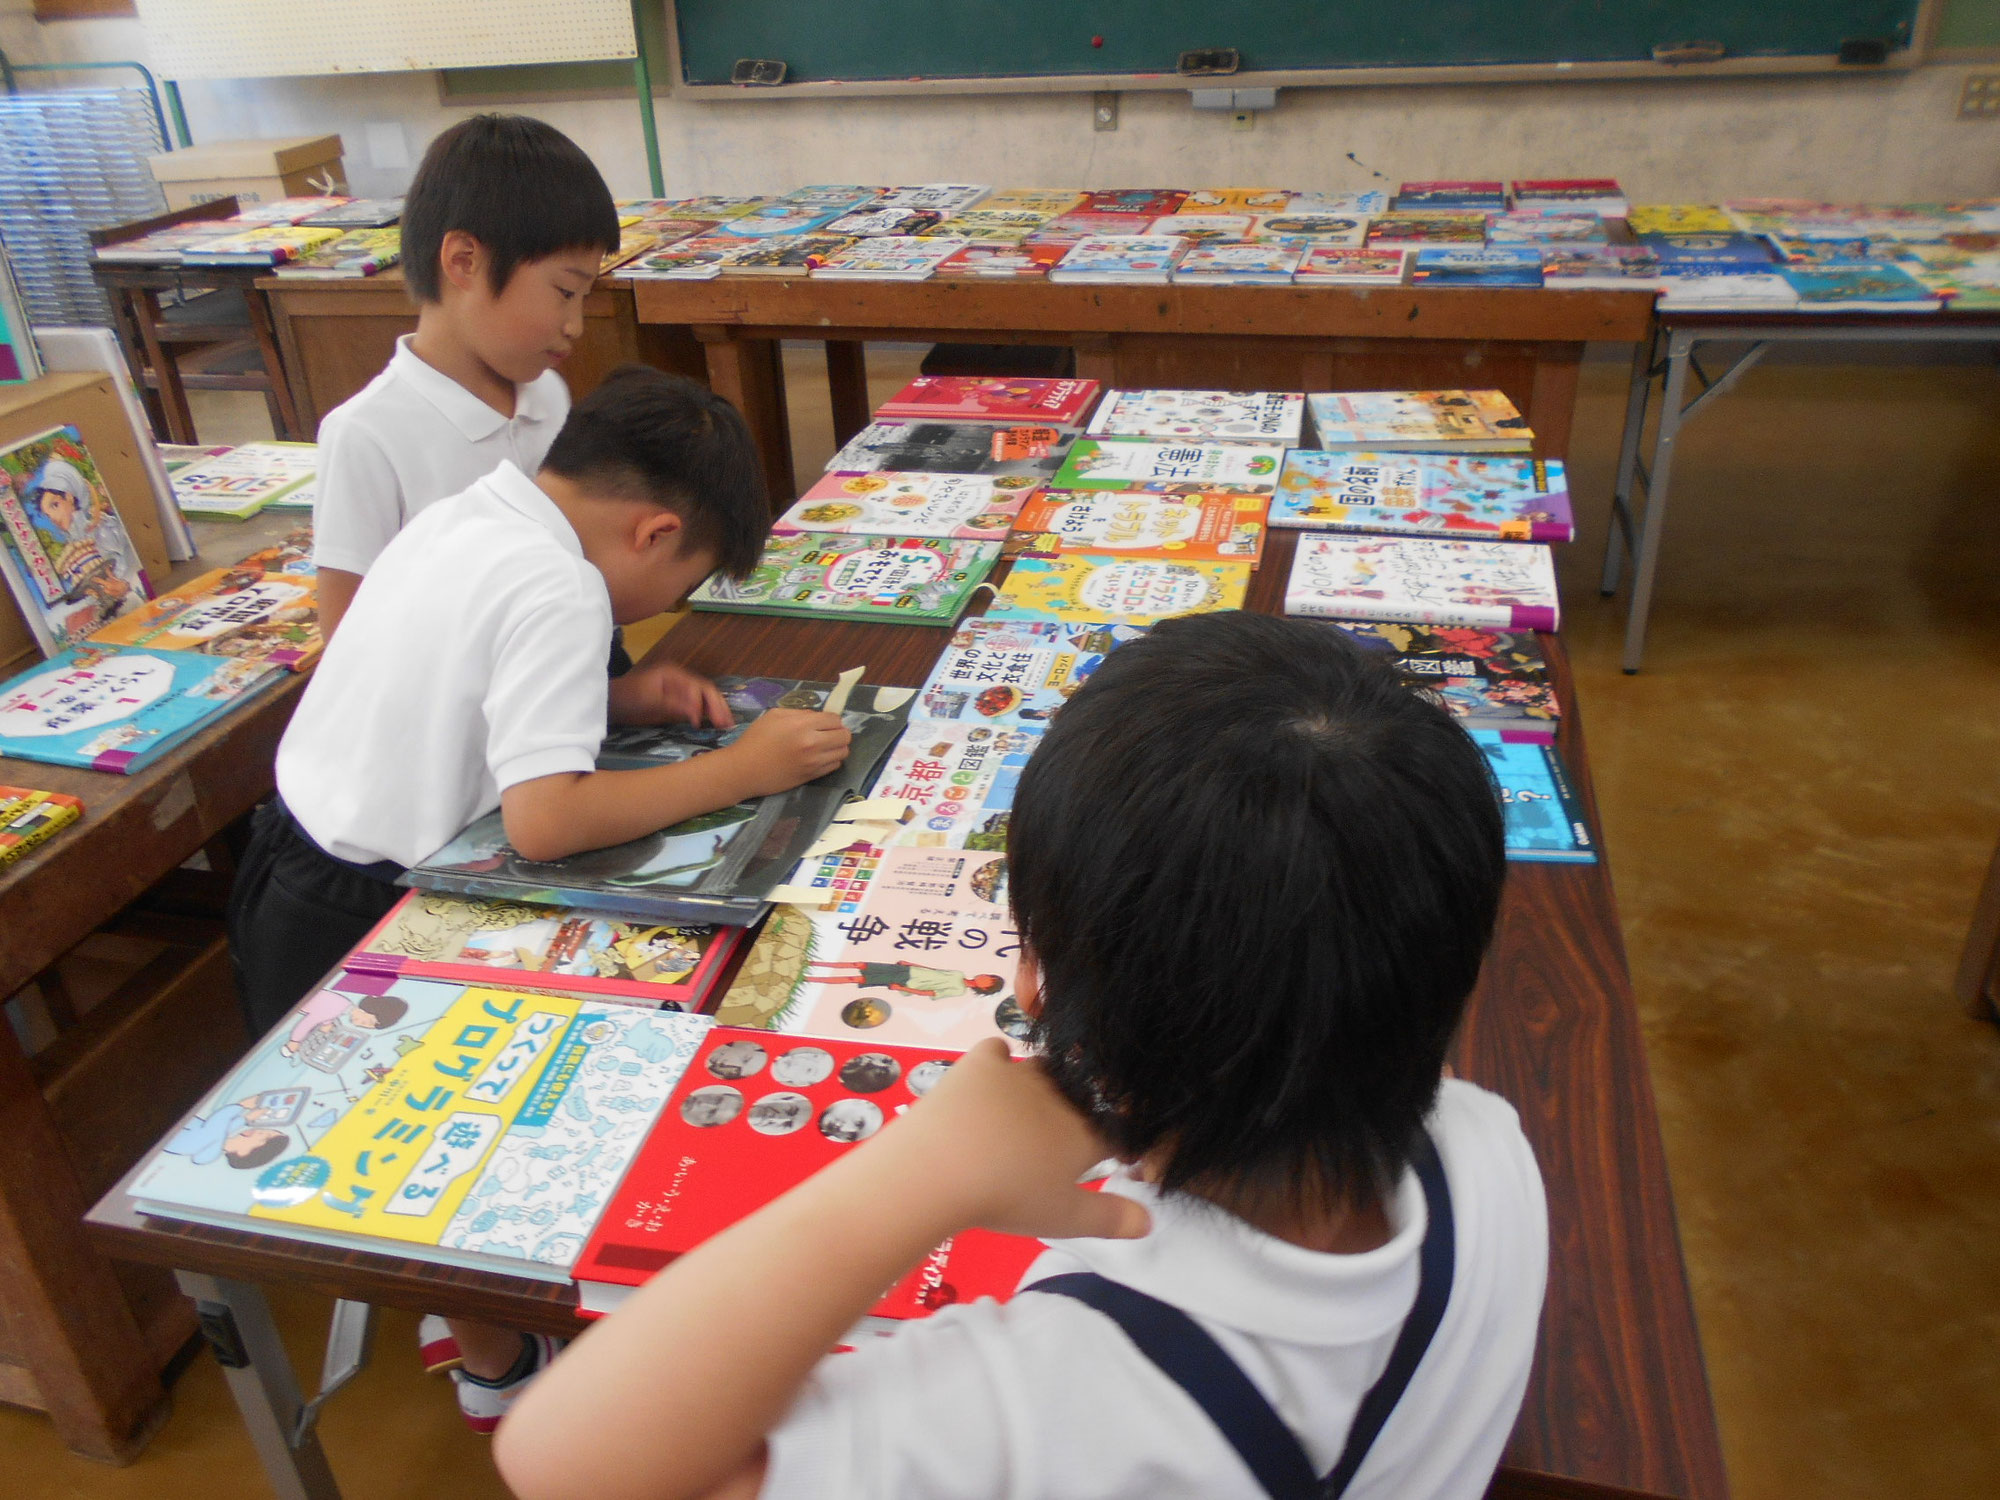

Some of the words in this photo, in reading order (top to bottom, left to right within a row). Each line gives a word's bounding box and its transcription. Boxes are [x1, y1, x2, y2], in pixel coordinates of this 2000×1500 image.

[1149, 447, 1204, 478] 憲法
[1338, 465, 1379, 505] 国の名前
[1057, 505, 1094, 532] さけよう
[1099, 501, 1155, 542] トラブル
[1146, 507, 1192, 538] ネット
[848, 549, 896, 594] おもてなし
[878, 551, 932, 590] 5か国語で
[948, 649, 982, 680] 世界の
[975, 651, 1008, 682] 文化と
[1000, 652, 1033, 683] 衣食住
[1048, 654, 1071, 687] ヨーロッパ
[892, 759, 948, 805] 京都
[926, 744, 991, 831] まるごと図鑑
[475, 1017, 556, 1097] つくって
[324, 998, 523, 1219] プログラミング
[405, 1120, 483, 1202] 遊べる
